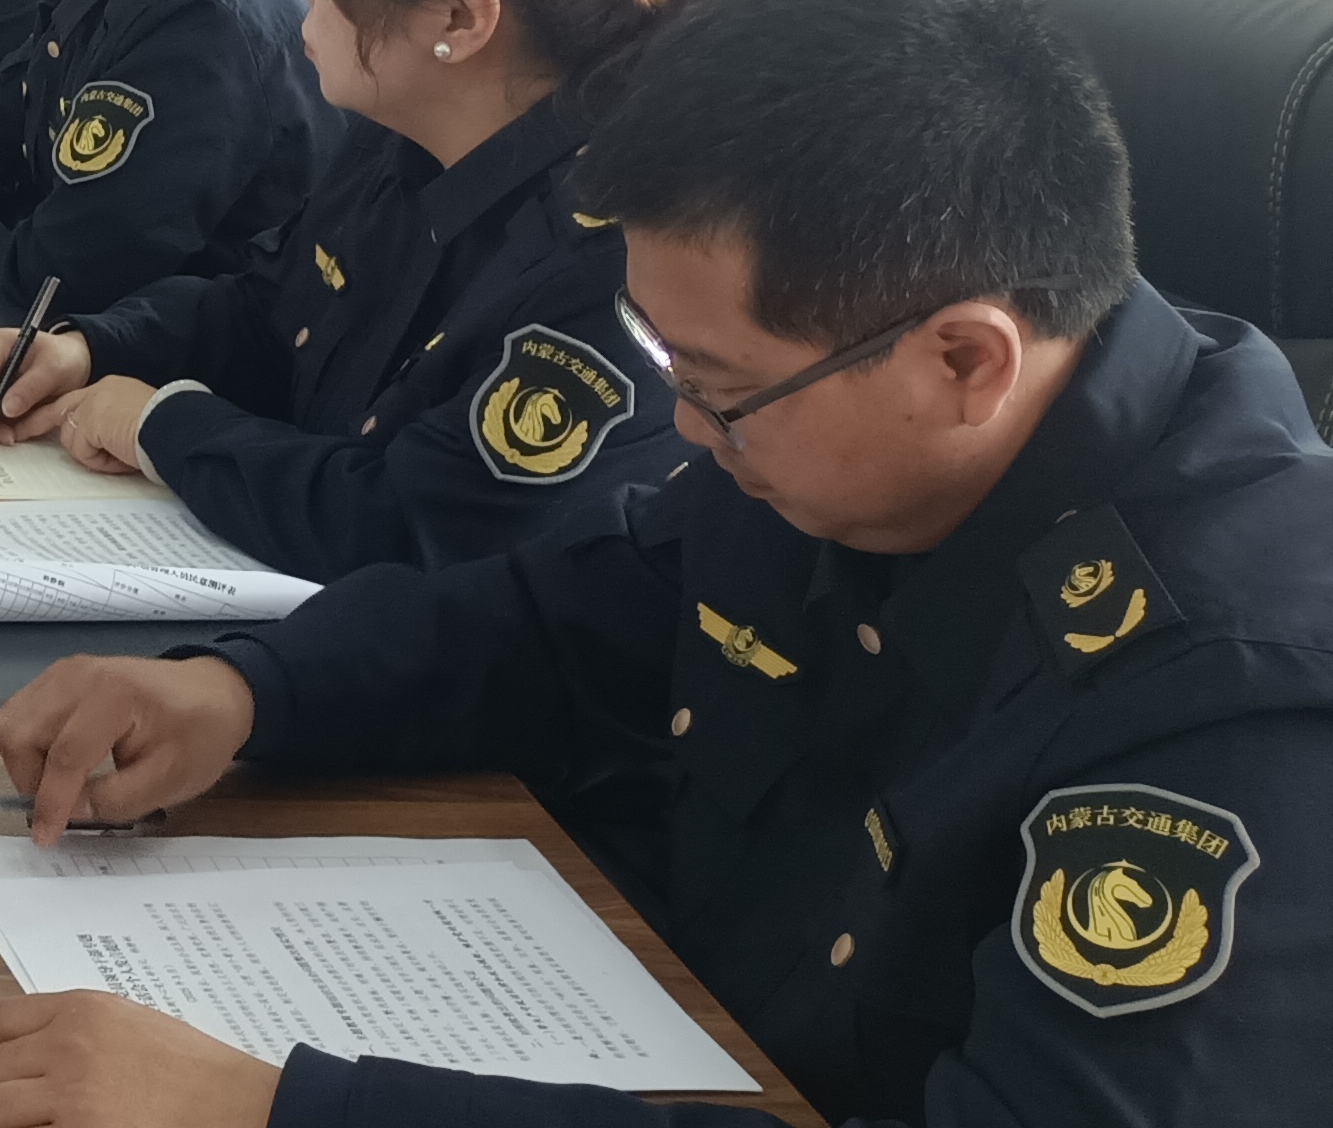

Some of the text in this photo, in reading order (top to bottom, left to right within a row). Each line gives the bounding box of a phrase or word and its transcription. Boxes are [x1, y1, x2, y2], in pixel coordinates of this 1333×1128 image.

[522, 339, 622, 409] 内蒙古交通集团
[1045, 805, 1229, 859] 内蒙古交通集团
